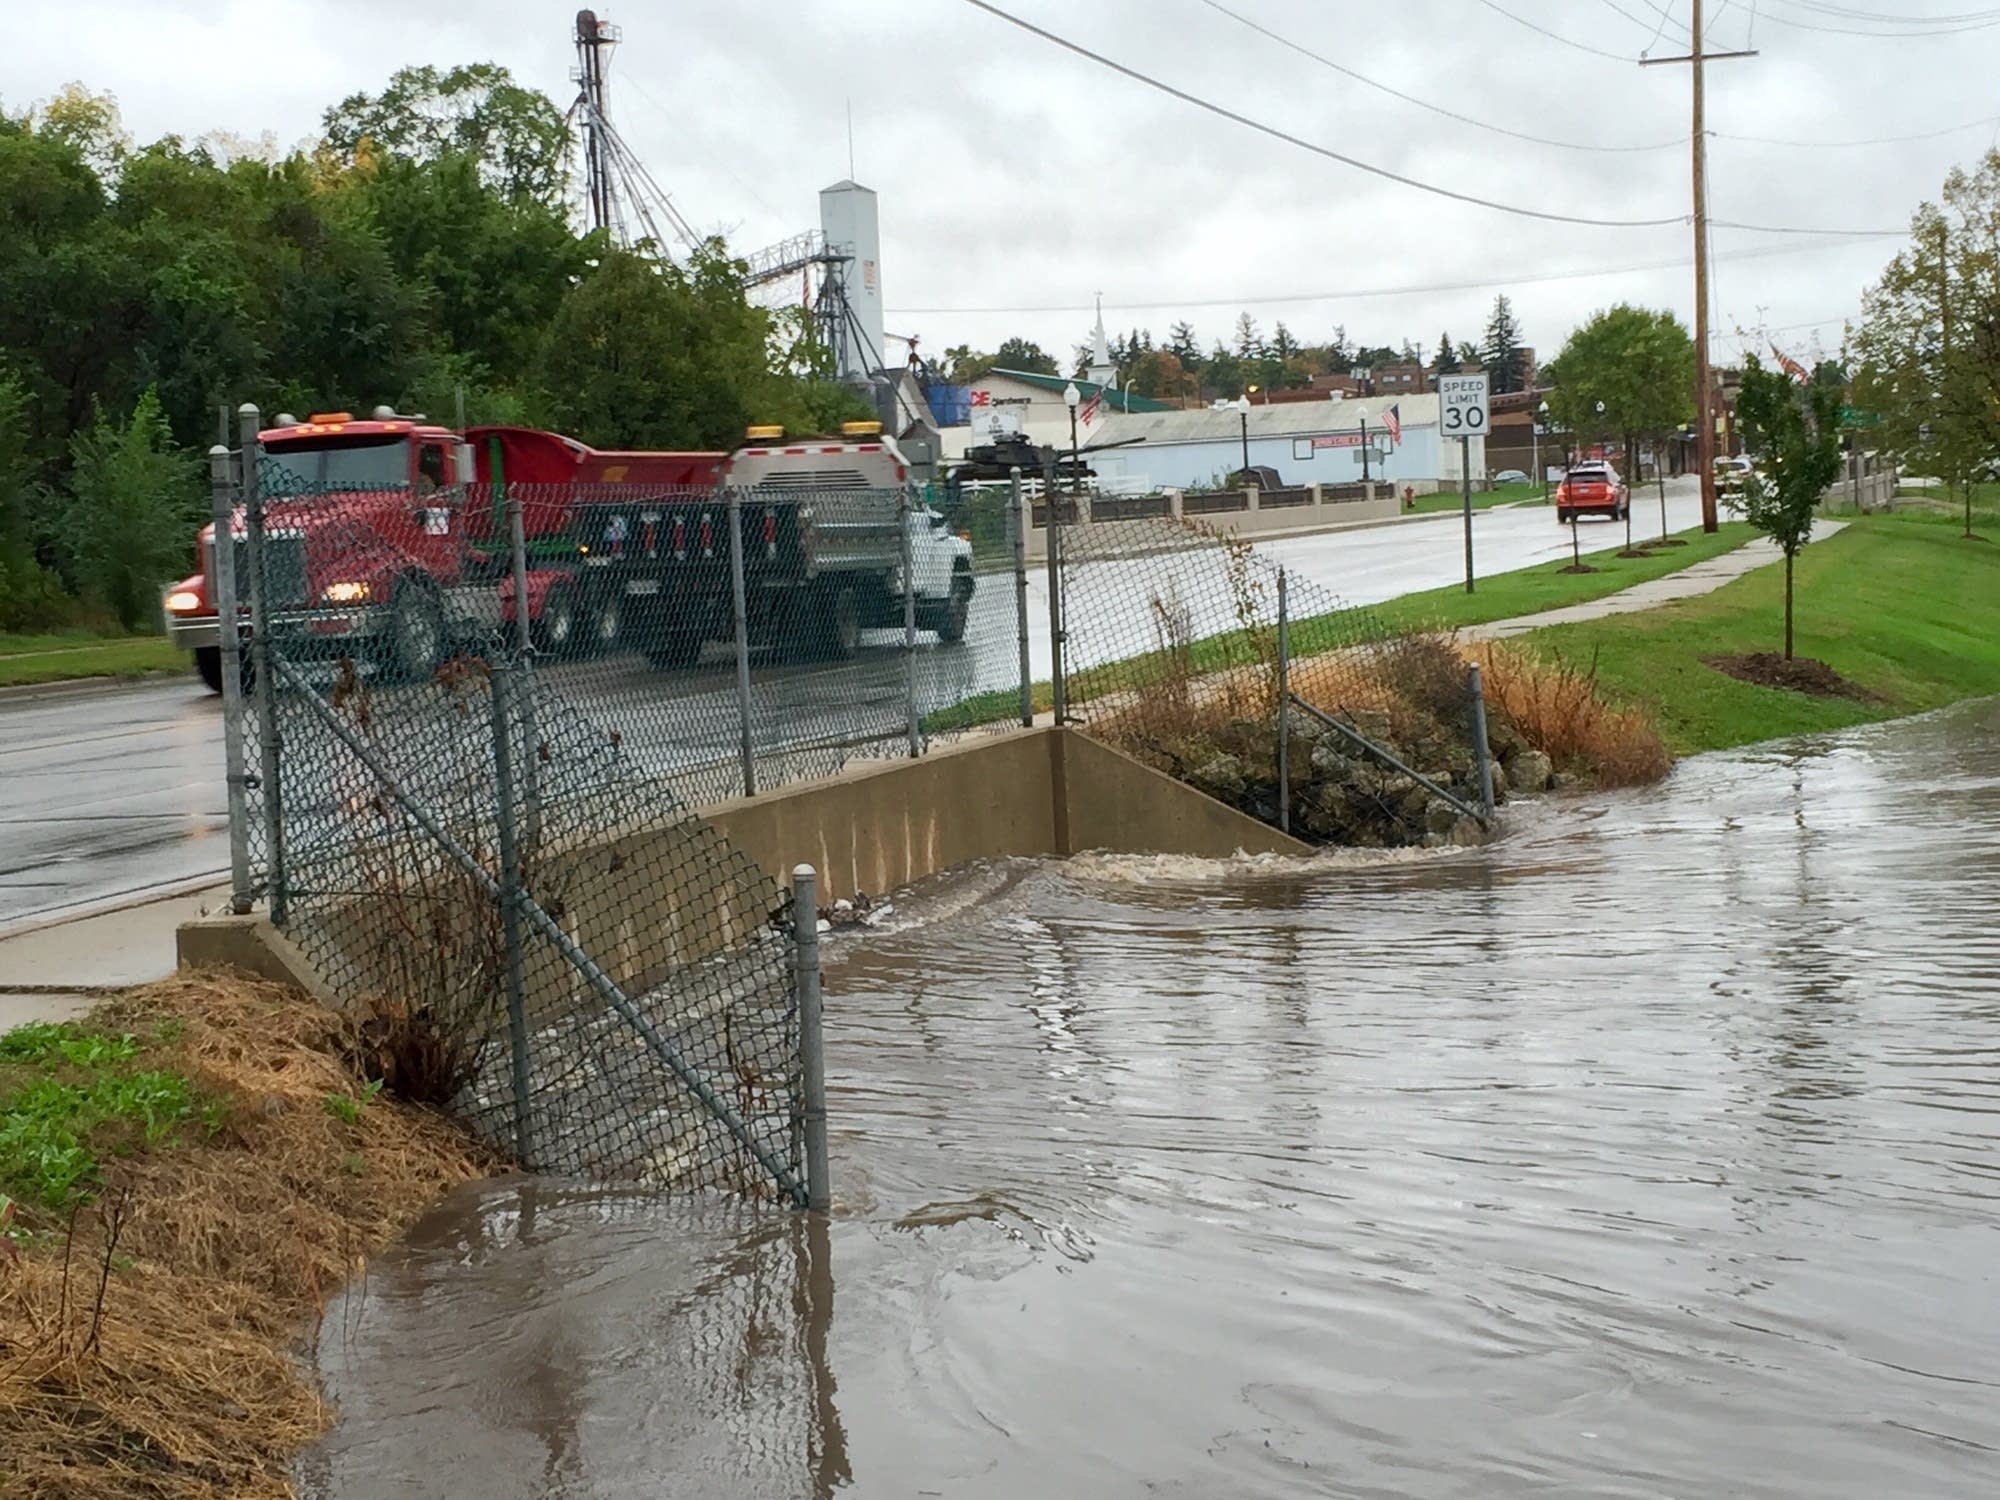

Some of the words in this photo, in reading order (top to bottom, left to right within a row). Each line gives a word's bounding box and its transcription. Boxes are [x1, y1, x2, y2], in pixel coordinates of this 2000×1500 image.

[1443, 381, 1484, 392] SPEED
[1447, 394, 1479, 405] LIMIT
[1445, 406, 1484, 429] 30
